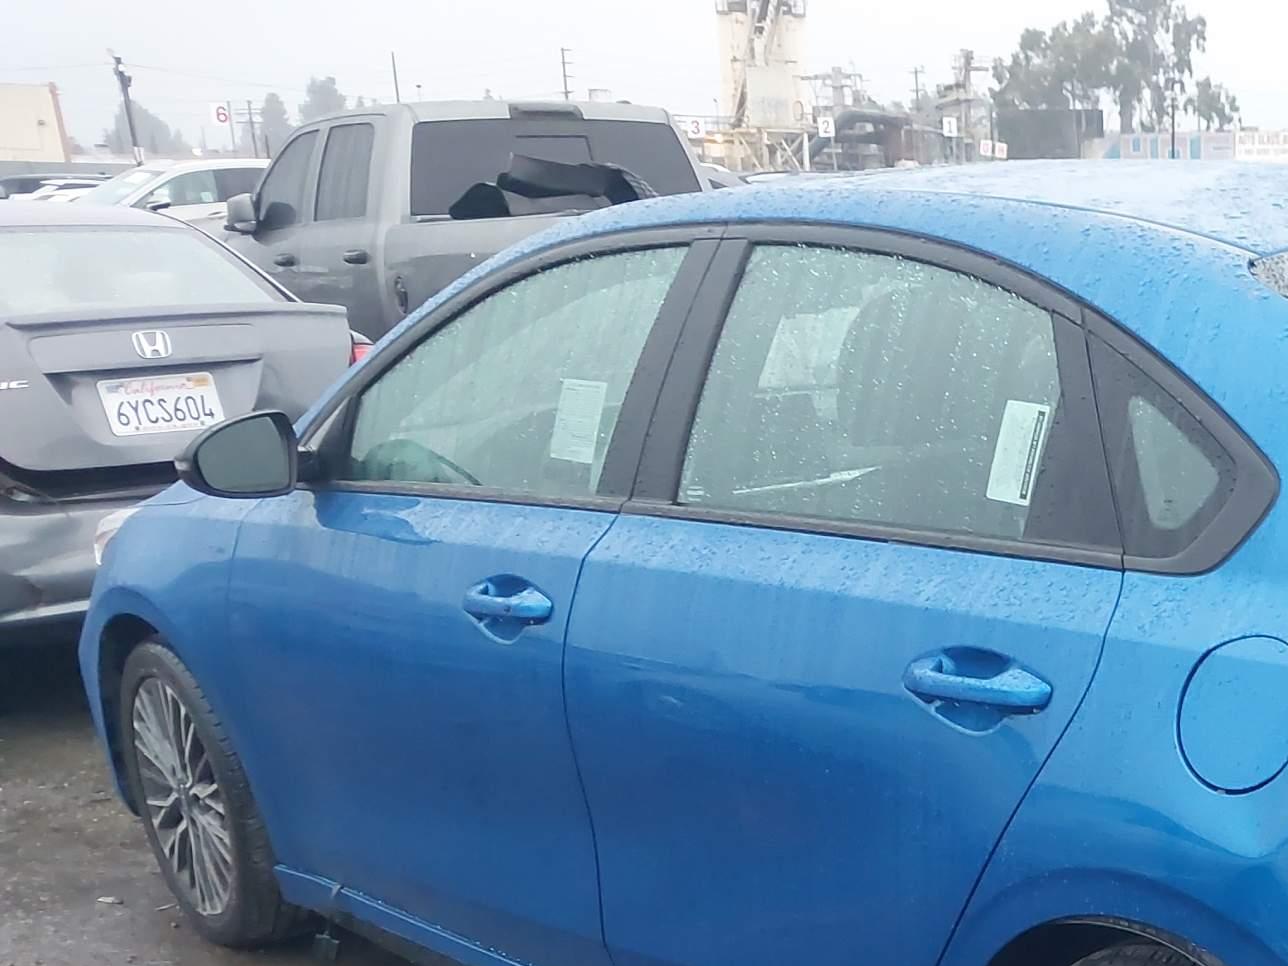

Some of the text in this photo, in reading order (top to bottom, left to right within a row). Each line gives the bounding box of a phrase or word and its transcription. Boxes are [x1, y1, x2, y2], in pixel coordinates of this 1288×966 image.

[216, 106, 228, 123] 6
[690, 119, 701, 135] 3
[822, 119, 831, 134] 2
[945, 119, 953, 134] 1
[117, 394, 215, 427] 6YCS604
